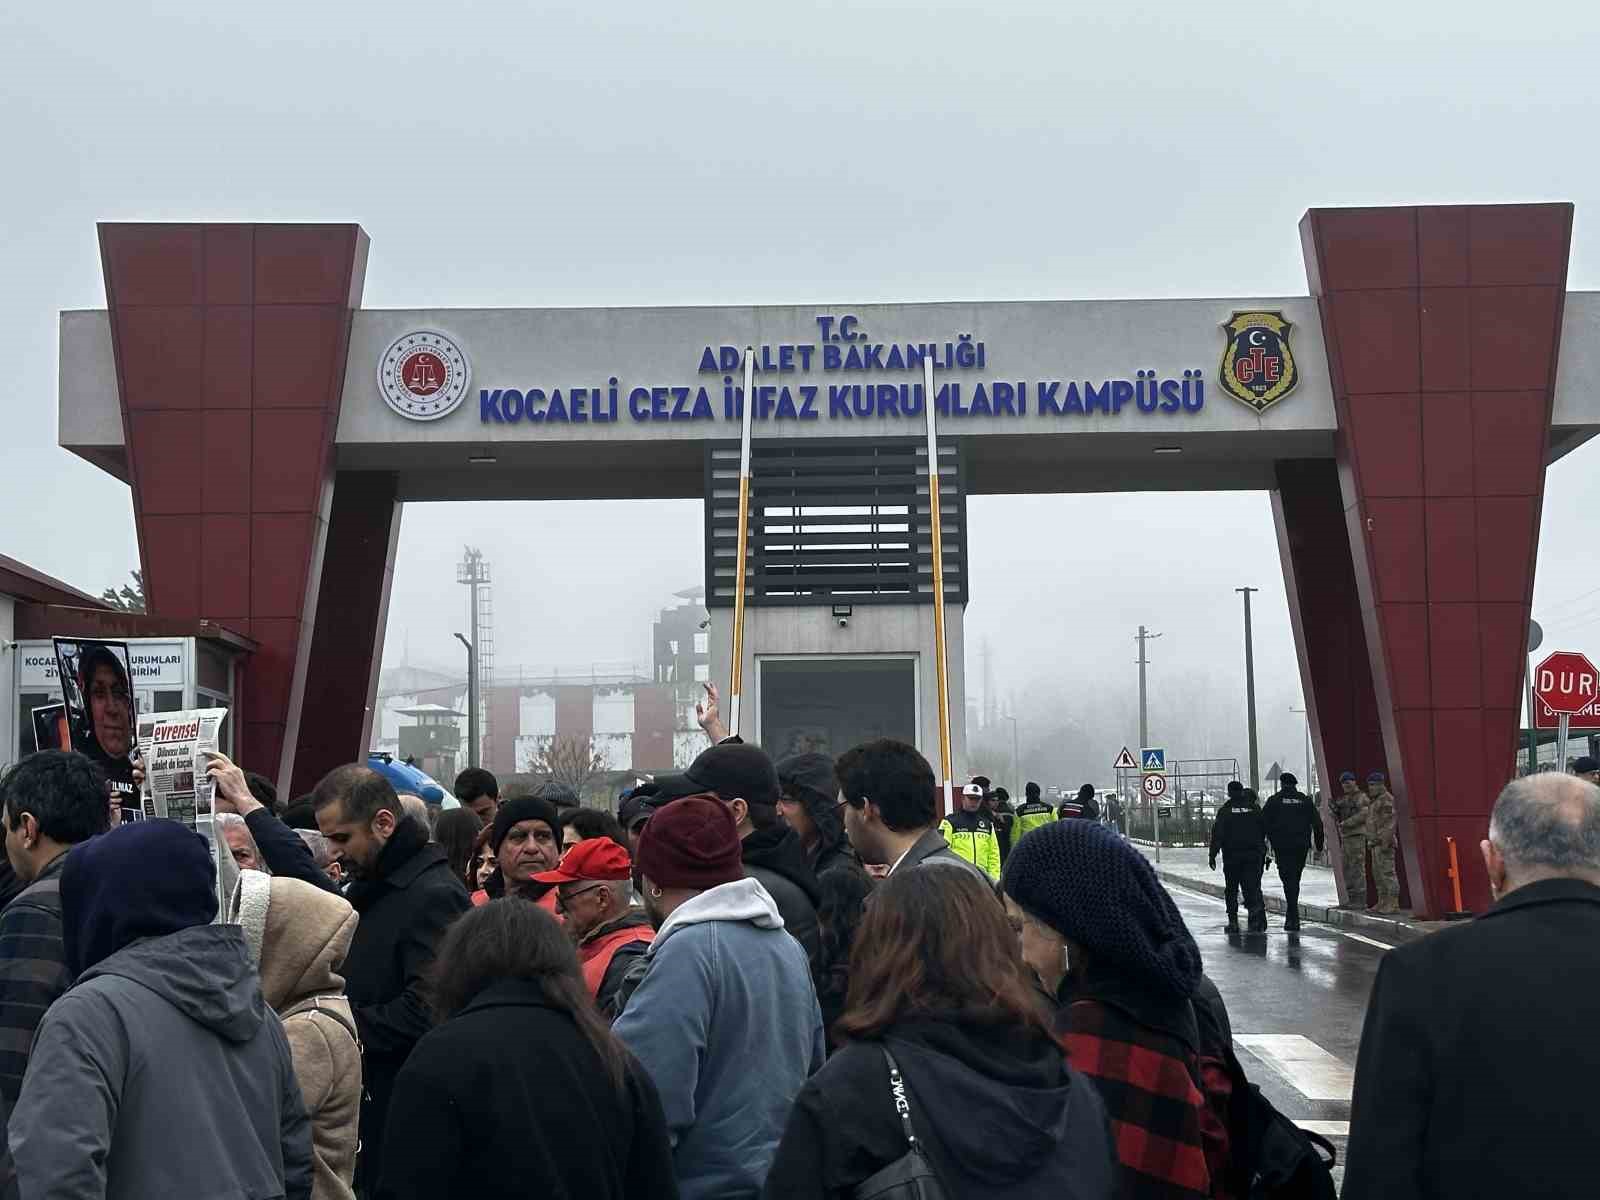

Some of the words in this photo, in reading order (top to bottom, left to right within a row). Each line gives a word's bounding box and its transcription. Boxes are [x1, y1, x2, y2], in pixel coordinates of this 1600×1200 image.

[816, 315, 868, 343] T.C.
[824, 333, 985, 370] BAKANLIĞI
[480, 377, 618, 423] KOCAELİ
[629, 387, 715, 422] CEZA
[1038, 369, 1204, 416] KAMPÜSÜ
[25, 656, 57, 666] KOCAE
[131, 655, 181, 665] URUMLARI
[1541, 670, 1592, 696] DUR
[154, 716, 201, 741] evrensel
[112, 781, 133, 793] ILMAZ
[1147, 779, 1162, 790] 30
